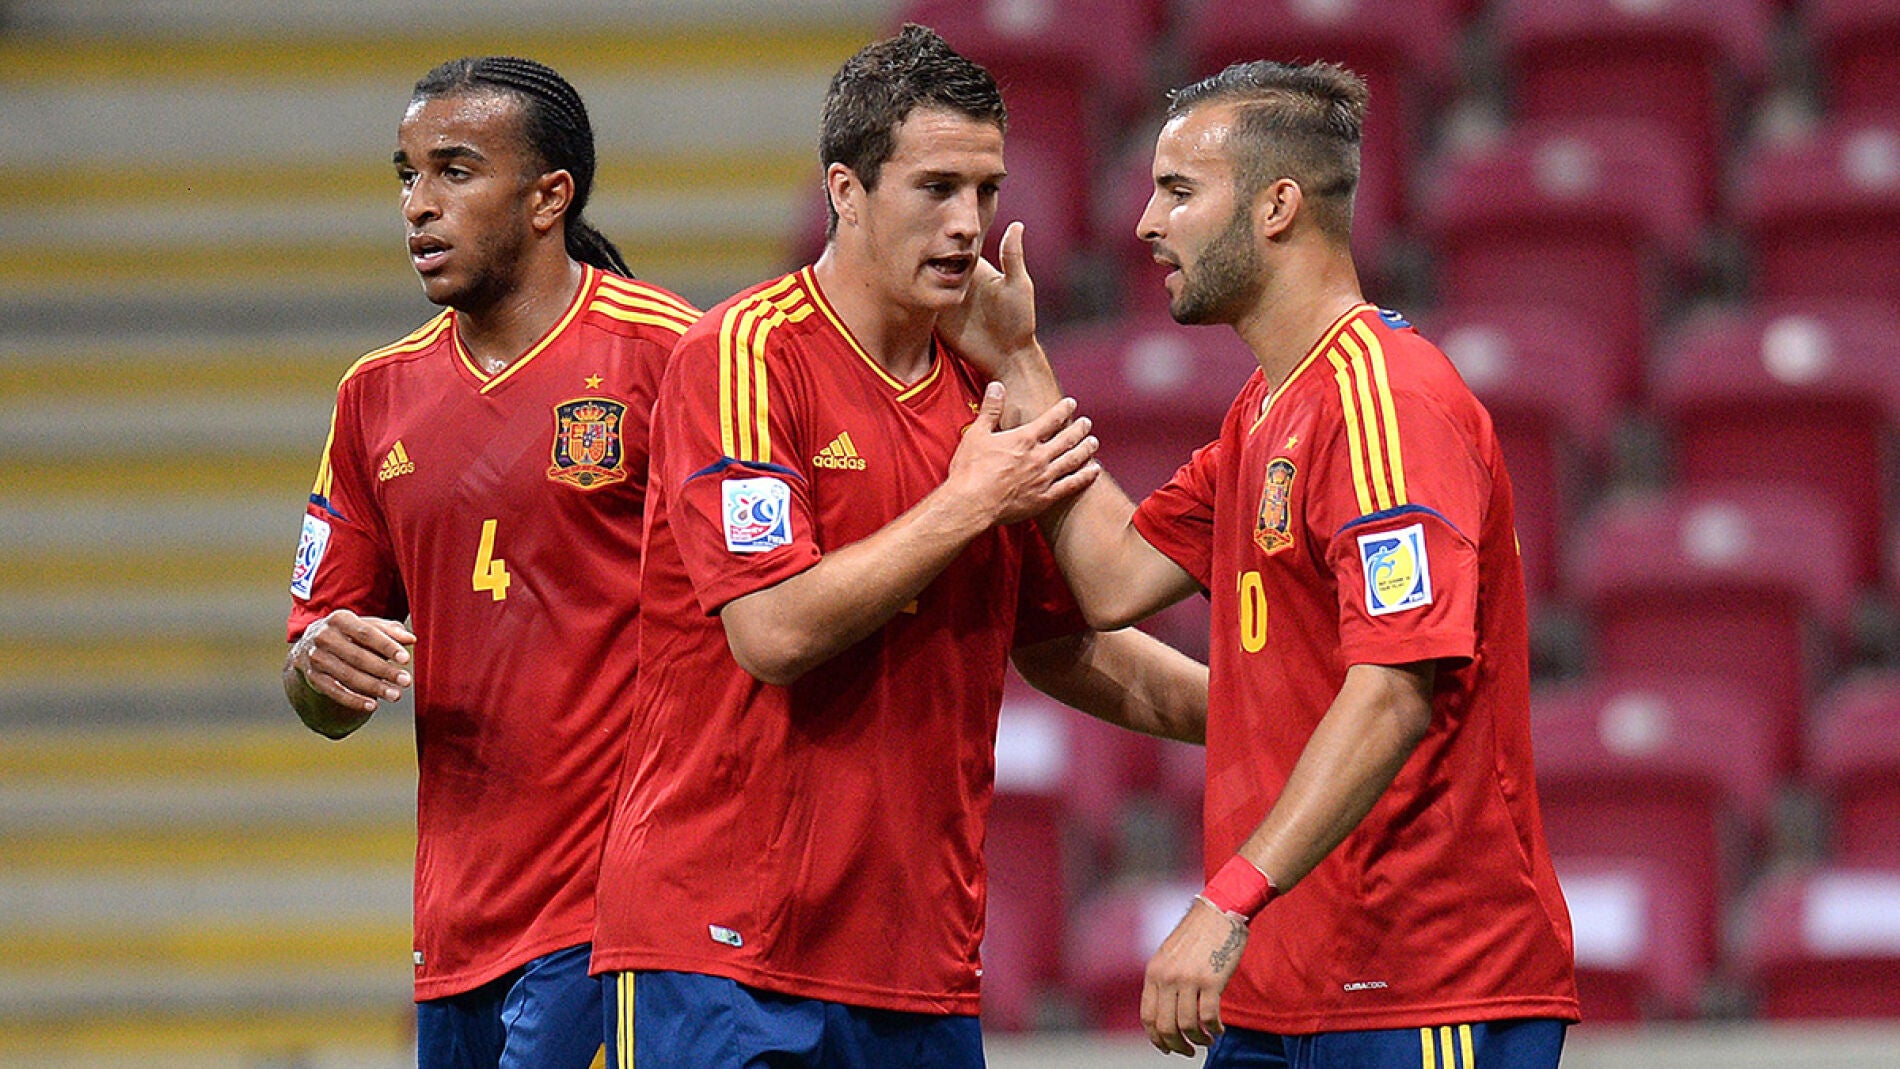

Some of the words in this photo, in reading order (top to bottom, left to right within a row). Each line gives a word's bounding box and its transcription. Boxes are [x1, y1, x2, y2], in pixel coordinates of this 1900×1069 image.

[379, 462, 415, 481] adidas
[812, 455, 867, 470] adidas
[472, 519, 510, 600] 4
[1237, 571, 1267, 653] 0
